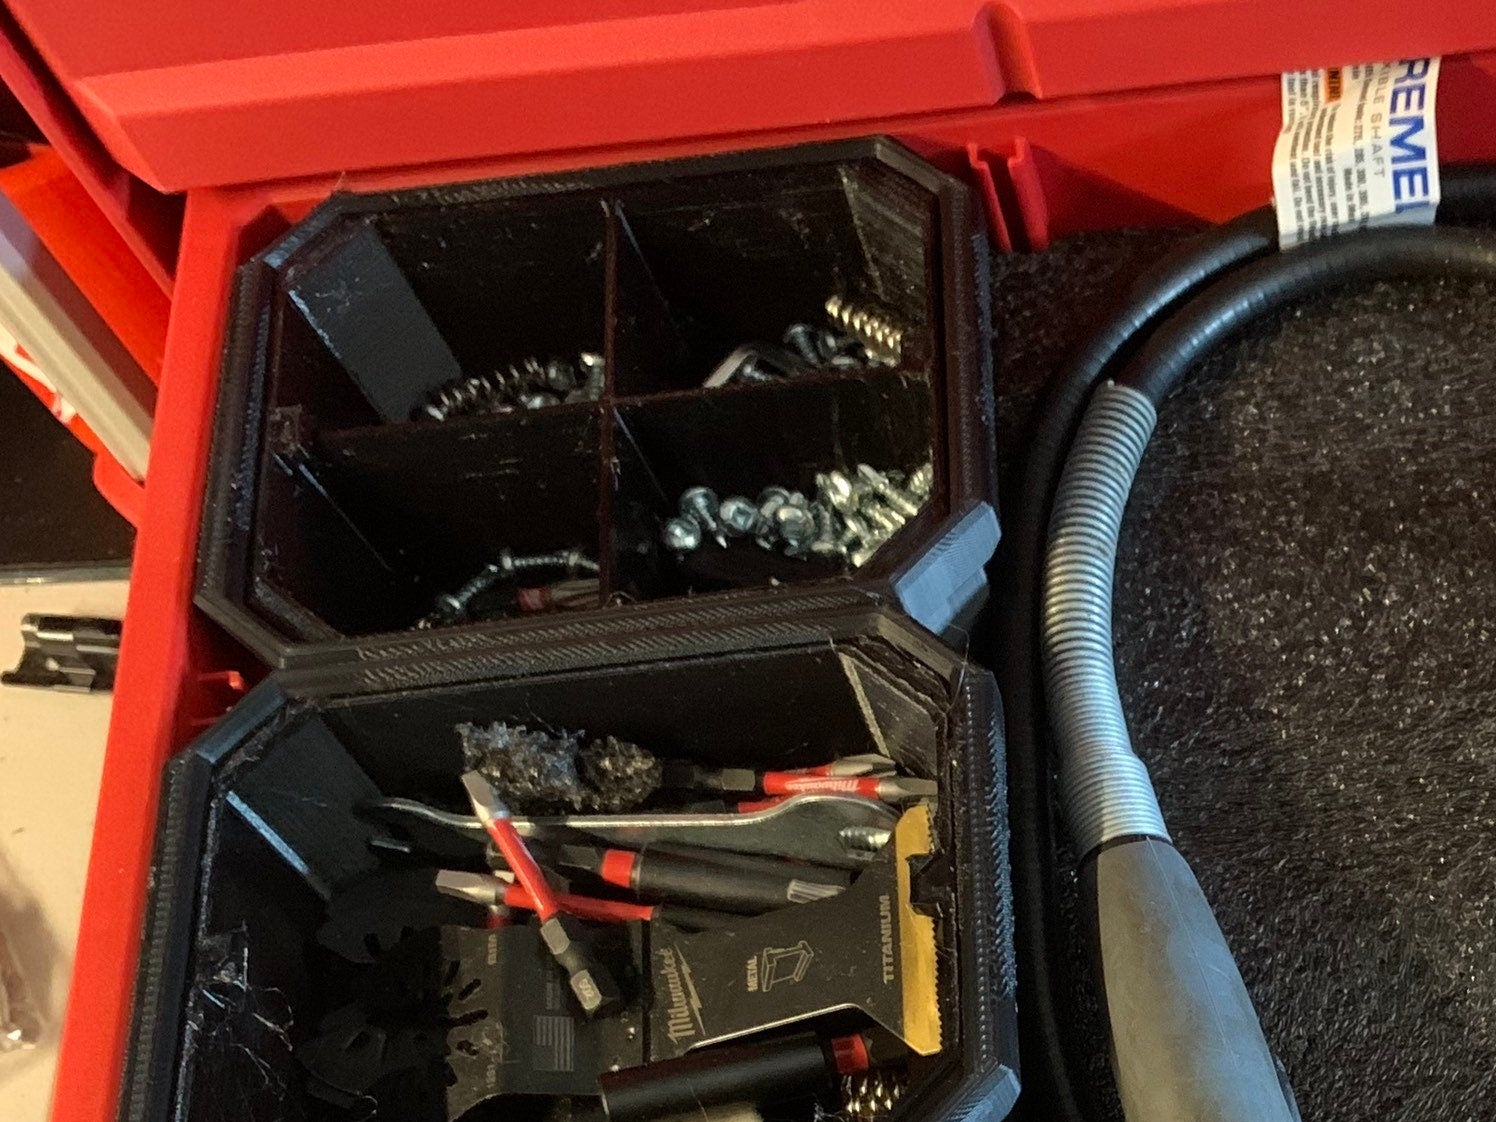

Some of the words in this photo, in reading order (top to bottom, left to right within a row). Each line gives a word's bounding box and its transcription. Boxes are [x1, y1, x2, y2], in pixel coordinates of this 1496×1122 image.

[1370, 112, 1385, 178] SHAFT
[746, 955, 758, 992] METAL
[879, 894, 894, 984] TITANIUM
[654, 948, 696, 1045] Milwaukee
